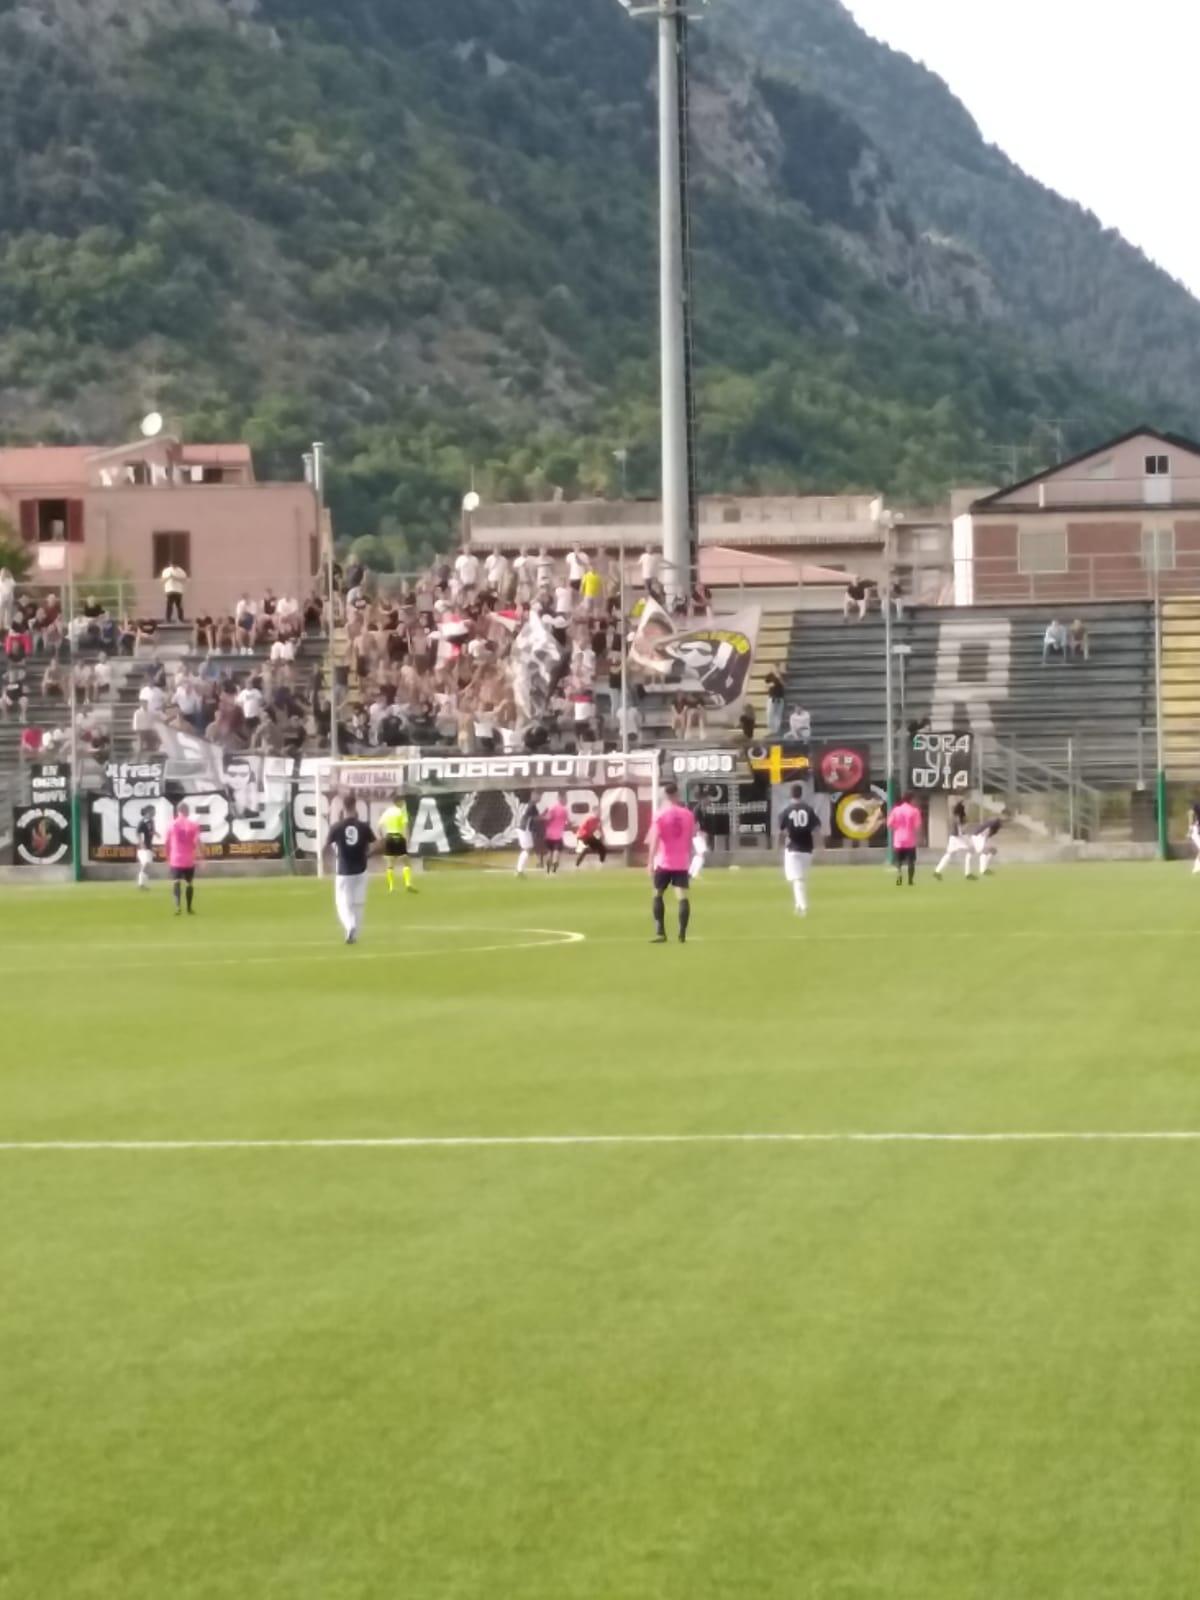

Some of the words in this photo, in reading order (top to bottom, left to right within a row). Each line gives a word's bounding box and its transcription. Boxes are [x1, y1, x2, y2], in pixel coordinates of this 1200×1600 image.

[912, 767, 969, 790] ODIA
[788, 808, 809, 828] 10
[344, 825, 359, 846] 9
